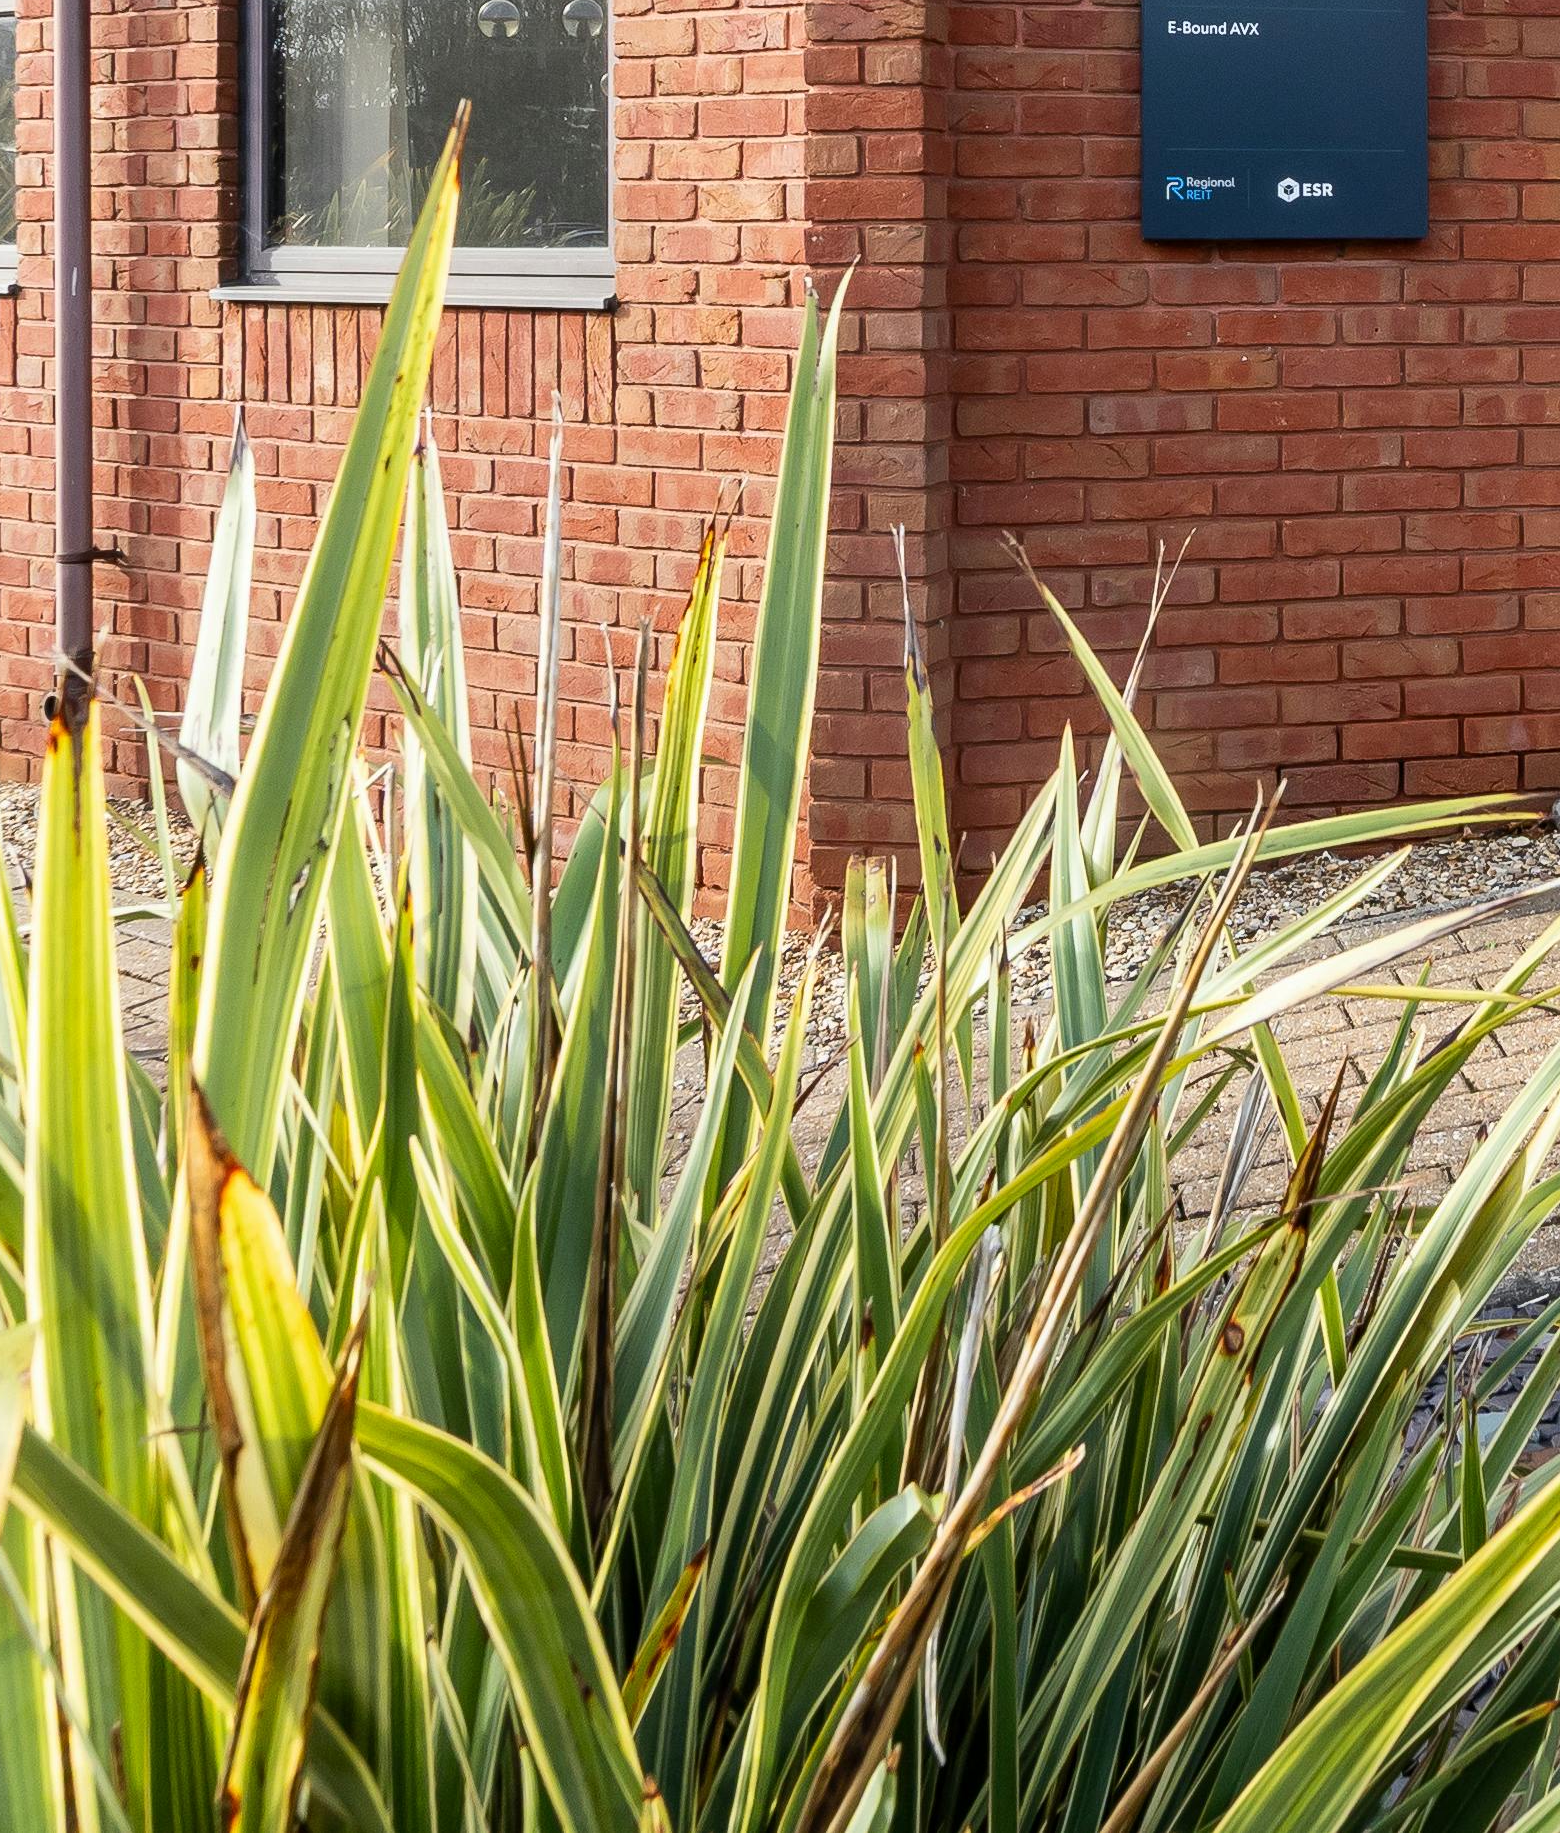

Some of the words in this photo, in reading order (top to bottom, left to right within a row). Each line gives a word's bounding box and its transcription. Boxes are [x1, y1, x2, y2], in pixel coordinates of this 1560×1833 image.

[1167, 21, 1227, 36] E-Bound
[1230, 22, 1260, 36] AVX
[1186, 177, 1236, 190] Regional
[1302, 183, 1333, 197] ESR
[1186, 188, 1213, 200] REIT
